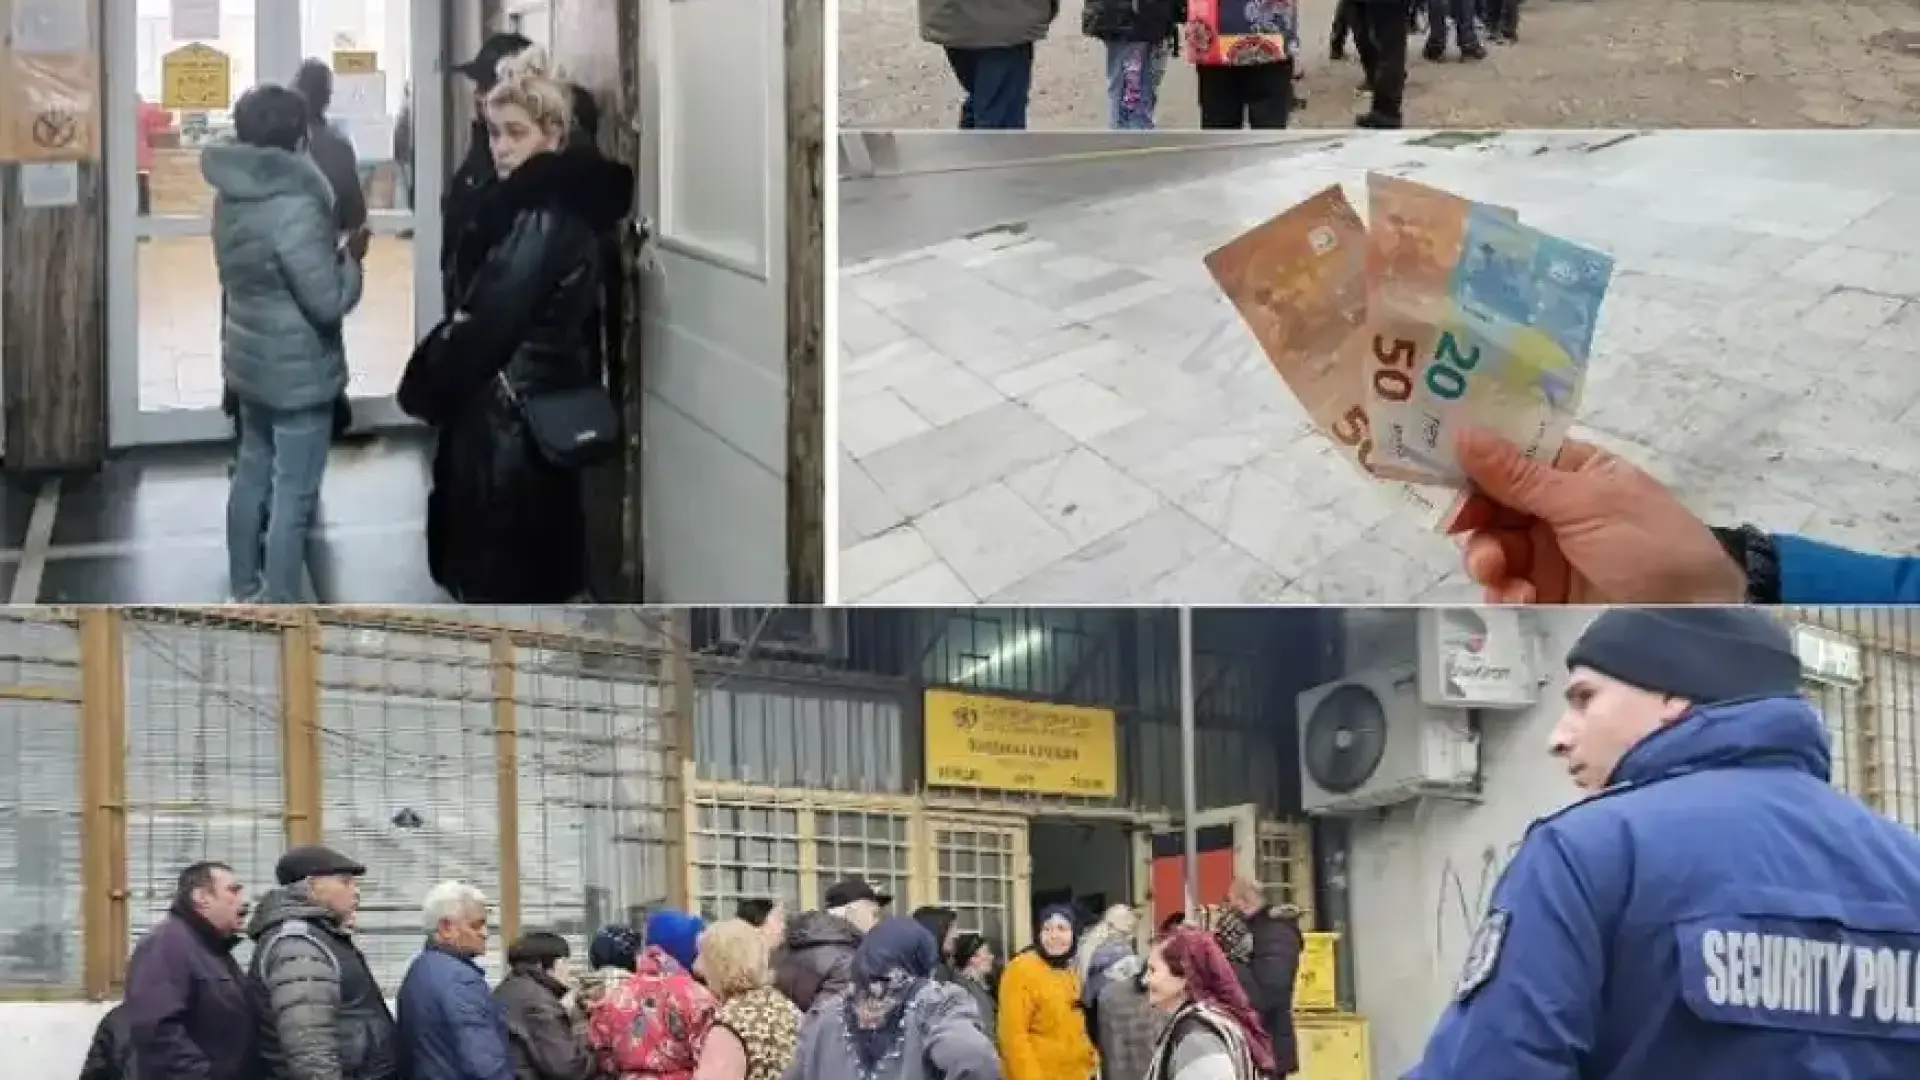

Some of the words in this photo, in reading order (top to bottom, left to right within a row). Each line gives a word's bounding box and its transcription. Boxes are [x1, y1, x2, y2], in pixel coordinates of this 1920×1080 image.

[1373, 333, 1416, 402] 50
[1425, 330, 1480, 400] 20
[1703, 929, 1850, 1016] SECURITY
